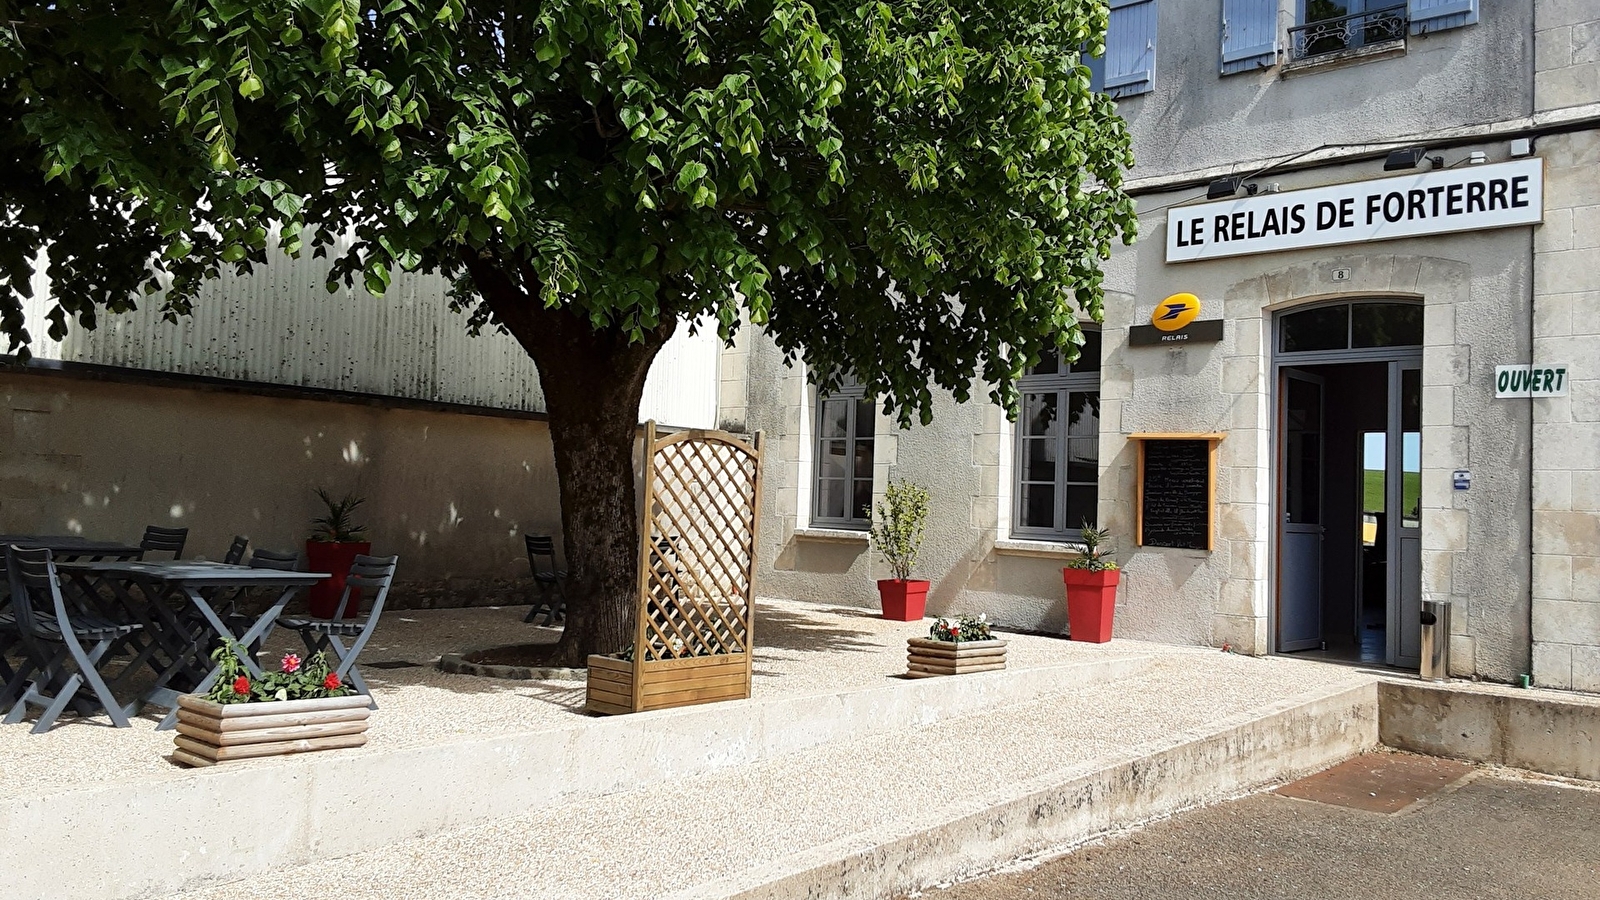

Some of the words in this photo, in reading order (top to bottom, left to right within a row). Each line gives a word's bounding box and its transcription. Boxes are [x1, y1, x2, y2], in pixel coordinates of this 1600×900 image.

[1177, 217, 1204, 248] LE
[1214, 203, 1306, 243] RELAIS
[1316, 198, 1355, 231] DE
[1366, 175, 1530, 225] FORTERRE
[1338, 270, 1344, 279] 8
[1497, 368, 1566, 393] OUVERT
